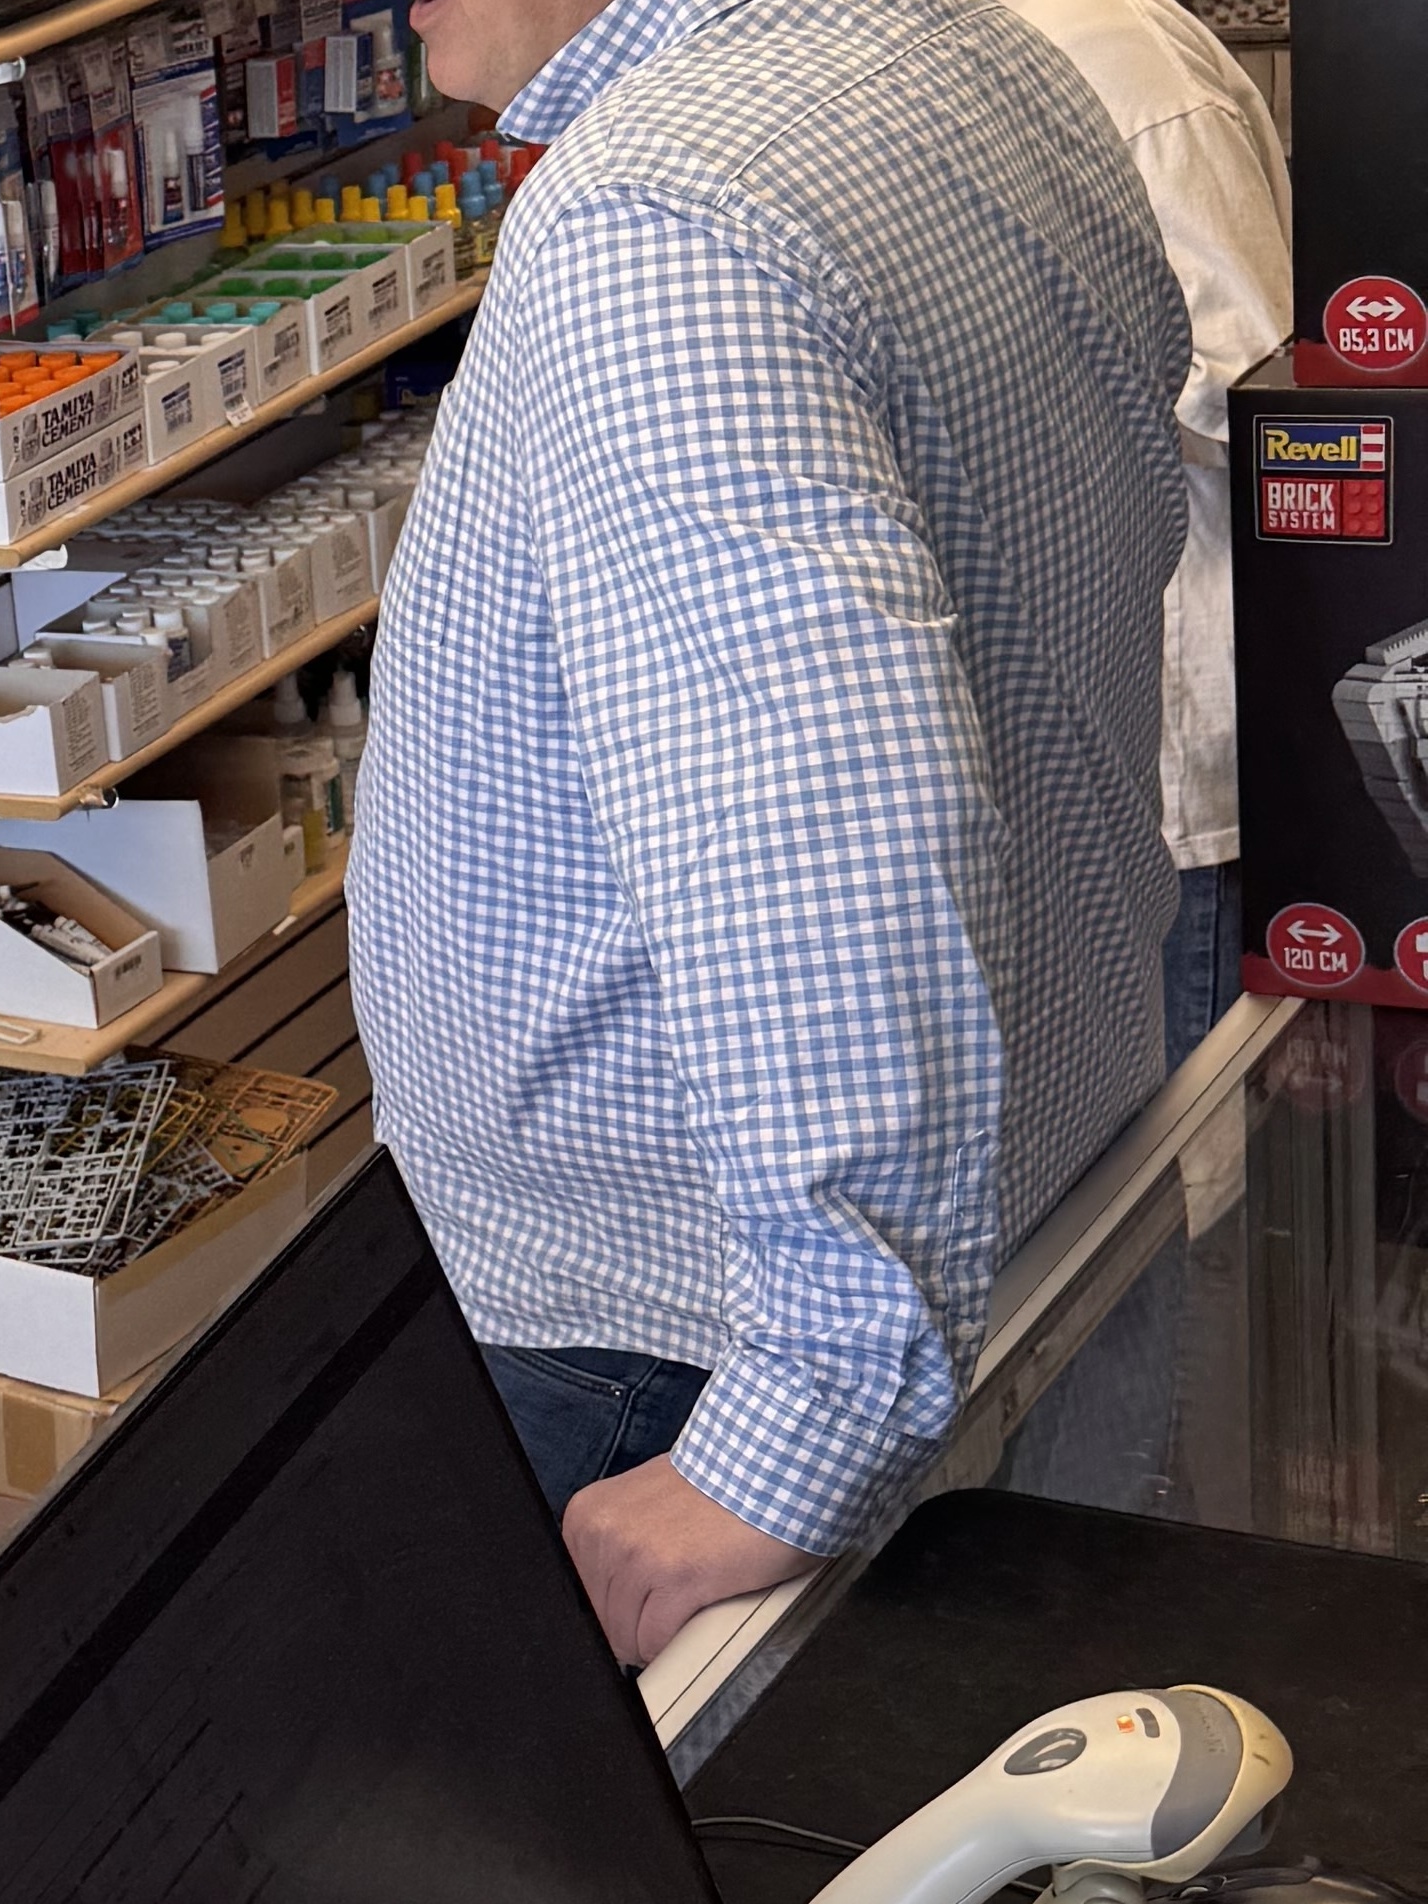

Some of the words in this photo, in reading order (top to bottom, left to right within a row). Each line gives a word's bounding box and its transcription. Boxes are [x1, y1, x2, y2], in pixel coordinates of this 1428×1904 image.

[1338, 329, 1381, 353] 85,3
[1384, 327, 1416, 353] CM
[41, 389, 95, 428] TAMIYA
[41, 410, 94, 448] CEMENT
[1266, 429, 1357, 465] Revell
[46, 452, 98, 491] TAMIYA
[46, 473, 98, 512] CEMENT
[1267, 482, 1335, 510] BRICK
[1268, 508, 1336, 533] SYSTEM
[1283, 946, 1310, 972] 120
[1313, 949, 1348, 974] CM
